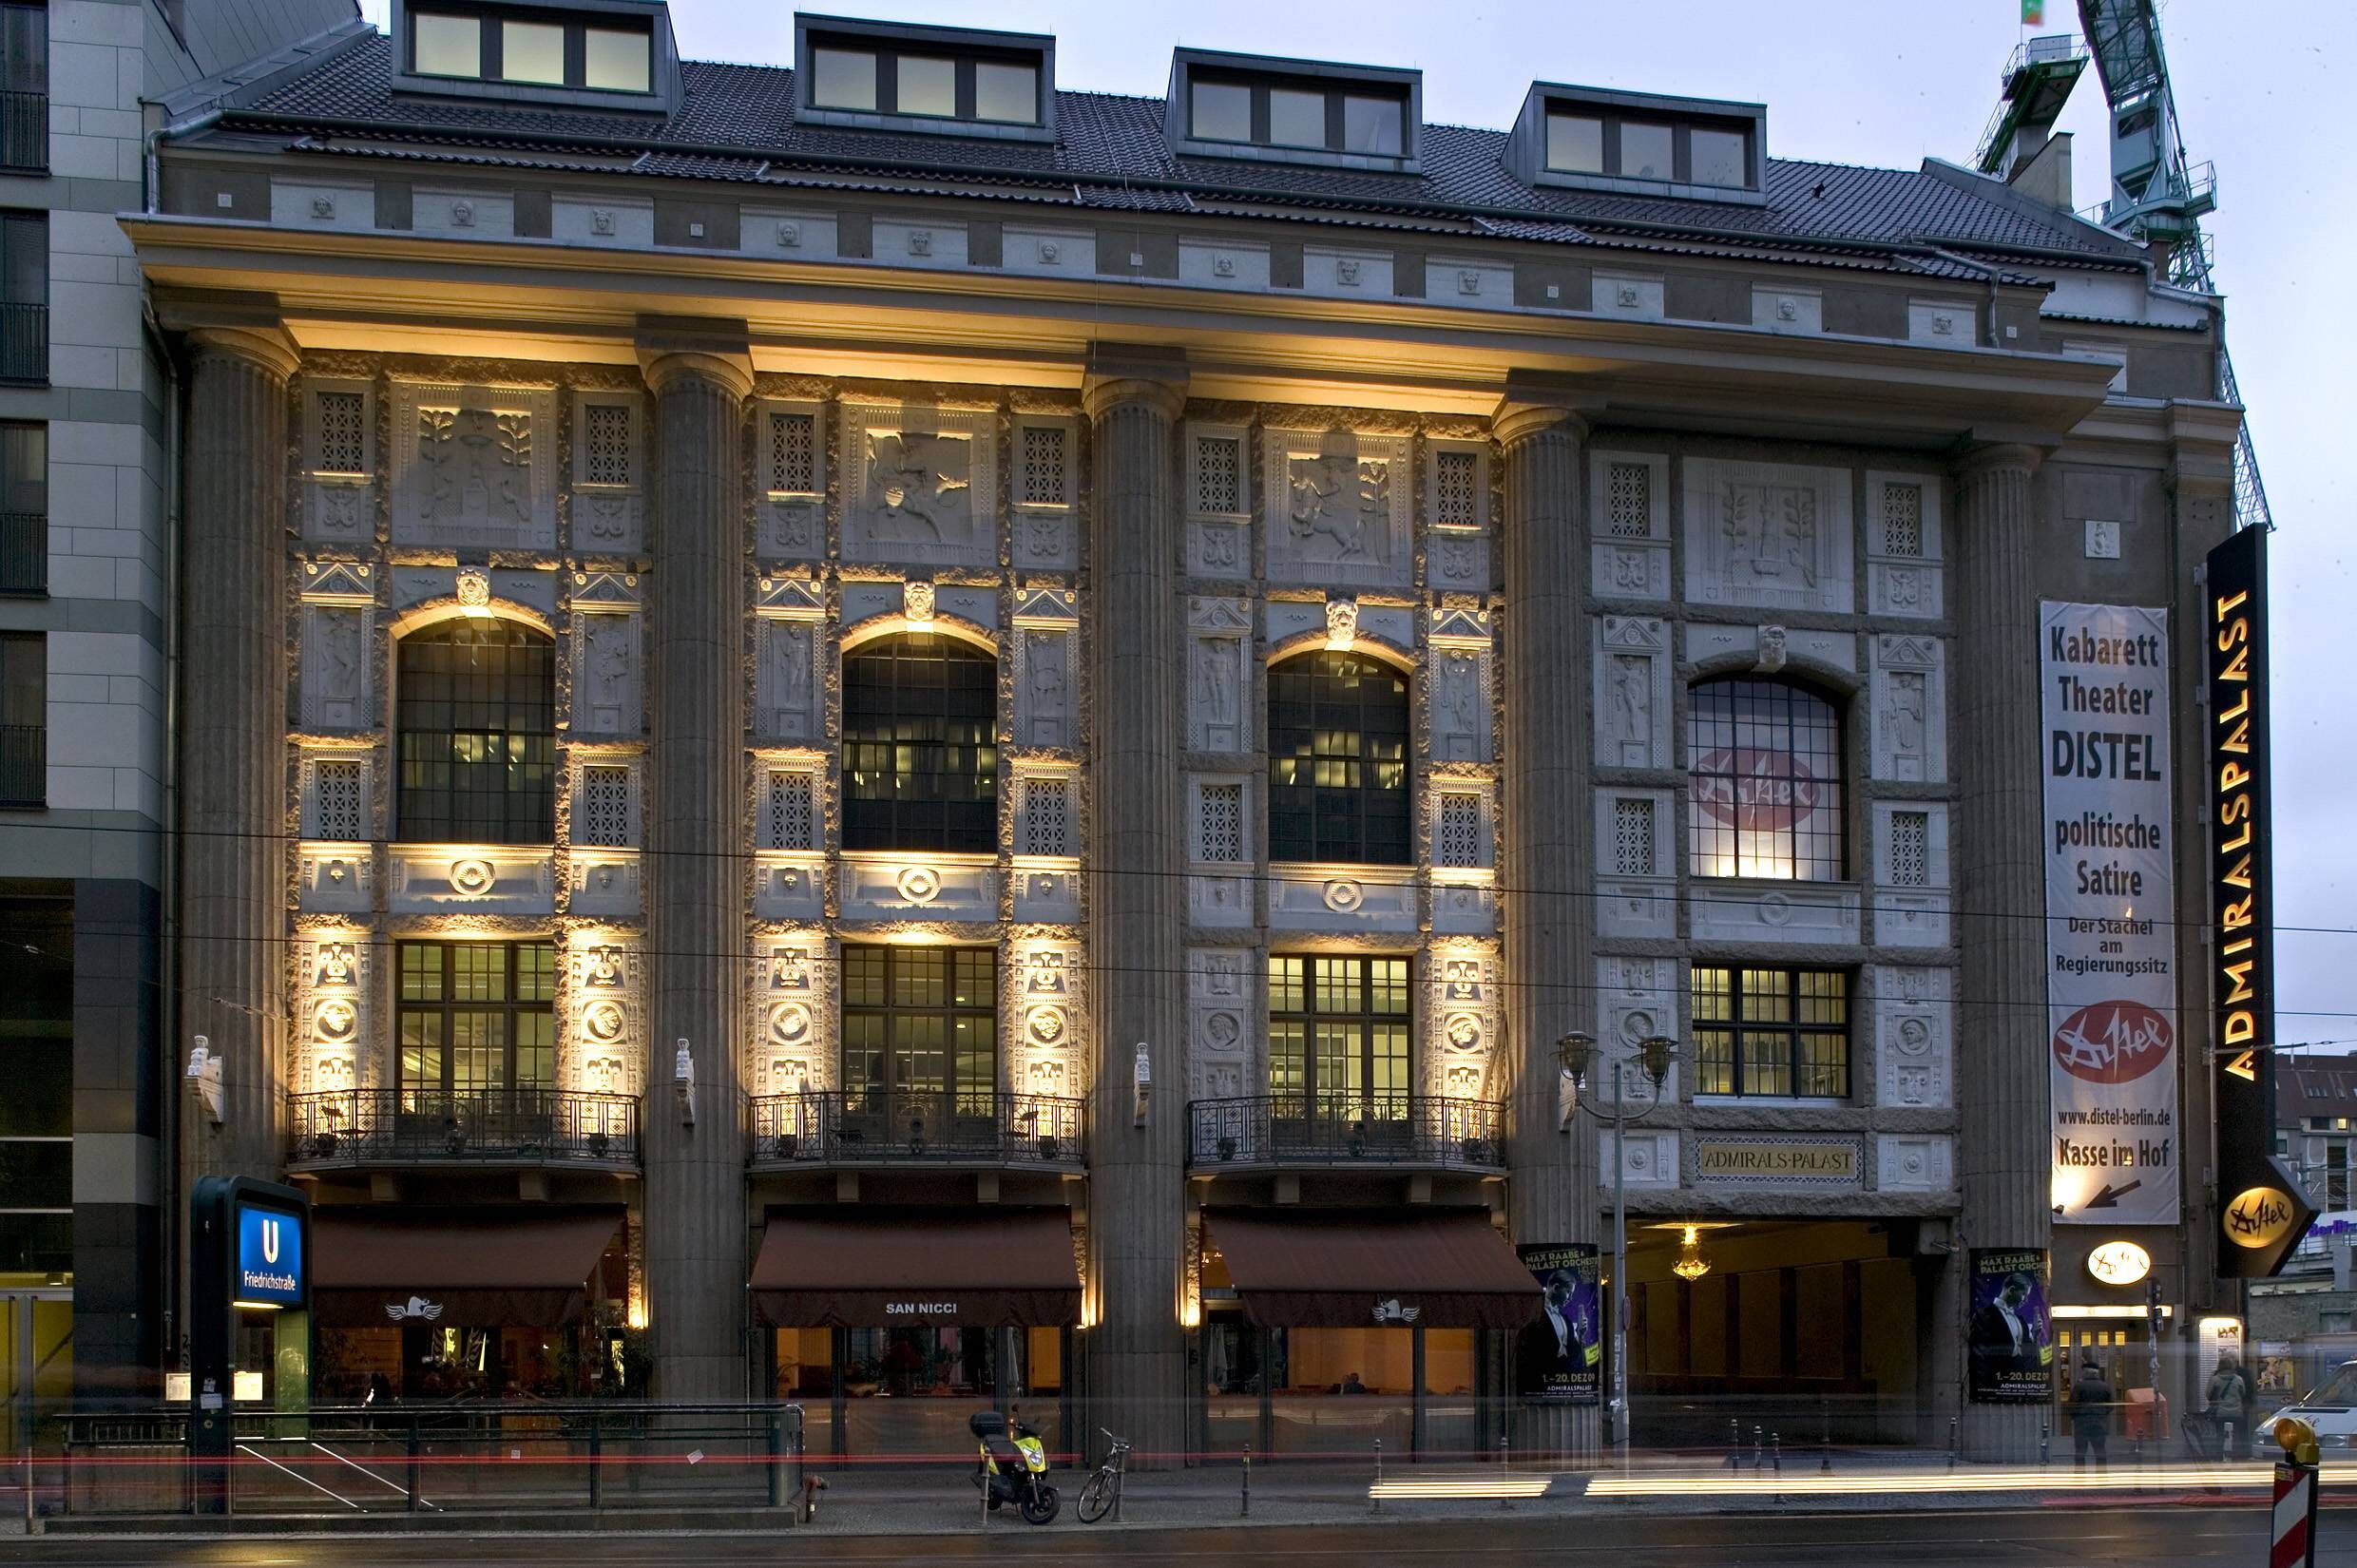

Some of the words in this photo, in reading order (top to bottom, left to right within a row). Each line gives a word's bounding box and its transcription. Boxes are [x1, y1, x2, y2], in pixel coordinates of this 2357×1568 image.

[2051, 625, 2159, 667] Kabarett
[2059, 676, 2153, 716] Theater
[2052, 730, 2161, 781] DISTEL
[2055, 812, 2160, 854] politische
[2217, 590, 2255, 1081] ADMIRALSPALAST
[2077, 860, 2142, 897] Satire
[2068, 917, 2094, 935] Der
[2098, 918, 2153, 936] Stachel
[2099, 940, 2123, 953] am
[2056, 955, 2168, 978] Regierungssitz
[2058, 1107, 2171, 1126] www.distel-berlin.de
[2059, 1138, 2108, 1167] Kasse
[2112, 1138, 2133, 1167] im
[2138, 1138, 2170, 1167] Hof
[261, 1218, 279, 1264] U
[1525, 1253, 1546, 1264] MAX
[1548, 1250, 1580, 1261] RAABE
[1980, 1256, 2002, 1267] MAX
[2004, 1253, 2036, 1265] RAABE
[1980, 1264, 2017, 1274] PALAST
[243, 1271, 296, 1291] Friedrichstraße
[886, 1303, 915, 1314] SAN
[918, 1303, 958, 1314] NICCI
